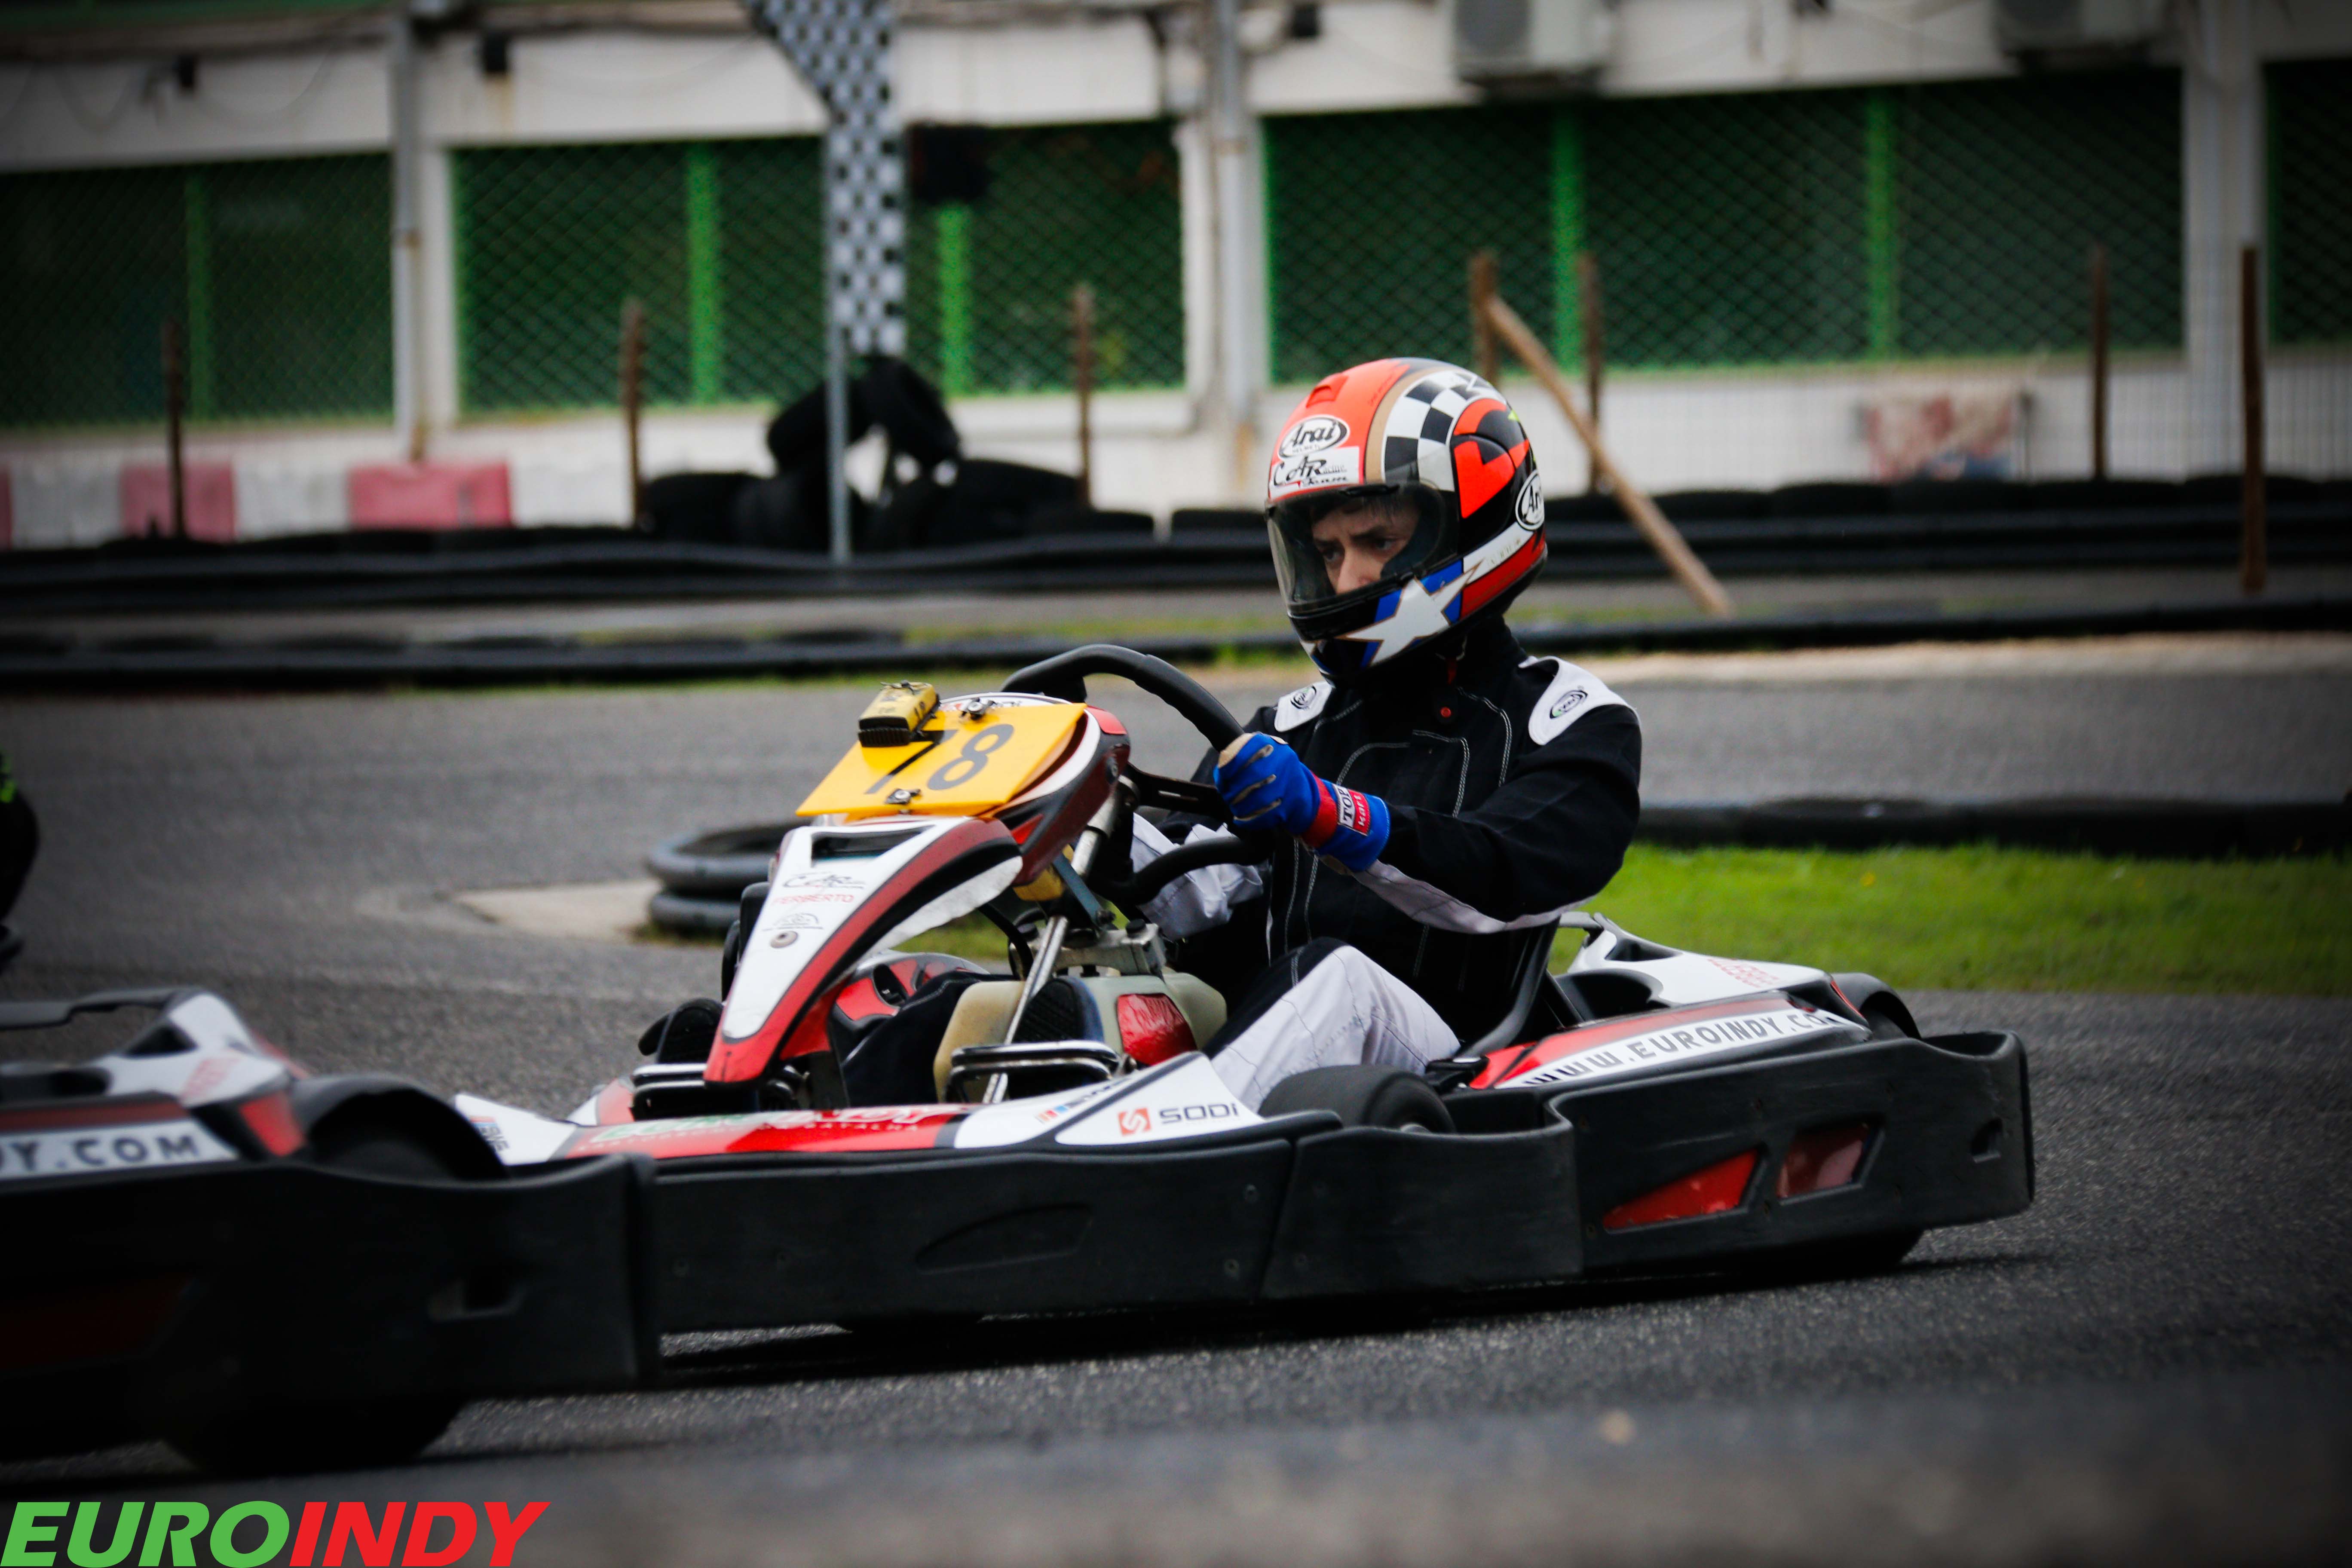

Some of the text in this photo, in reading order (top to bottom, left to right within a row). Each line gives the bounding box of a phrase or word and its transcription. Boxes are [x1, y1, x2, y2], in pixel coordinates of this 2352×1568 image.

[864, 723, 1015, 794] 78
[1337, 787, 1353, 821] TOP
[1161, 1103, 1234, 1124] SODI
[0, 1136, 200, 1172] Y.COM
